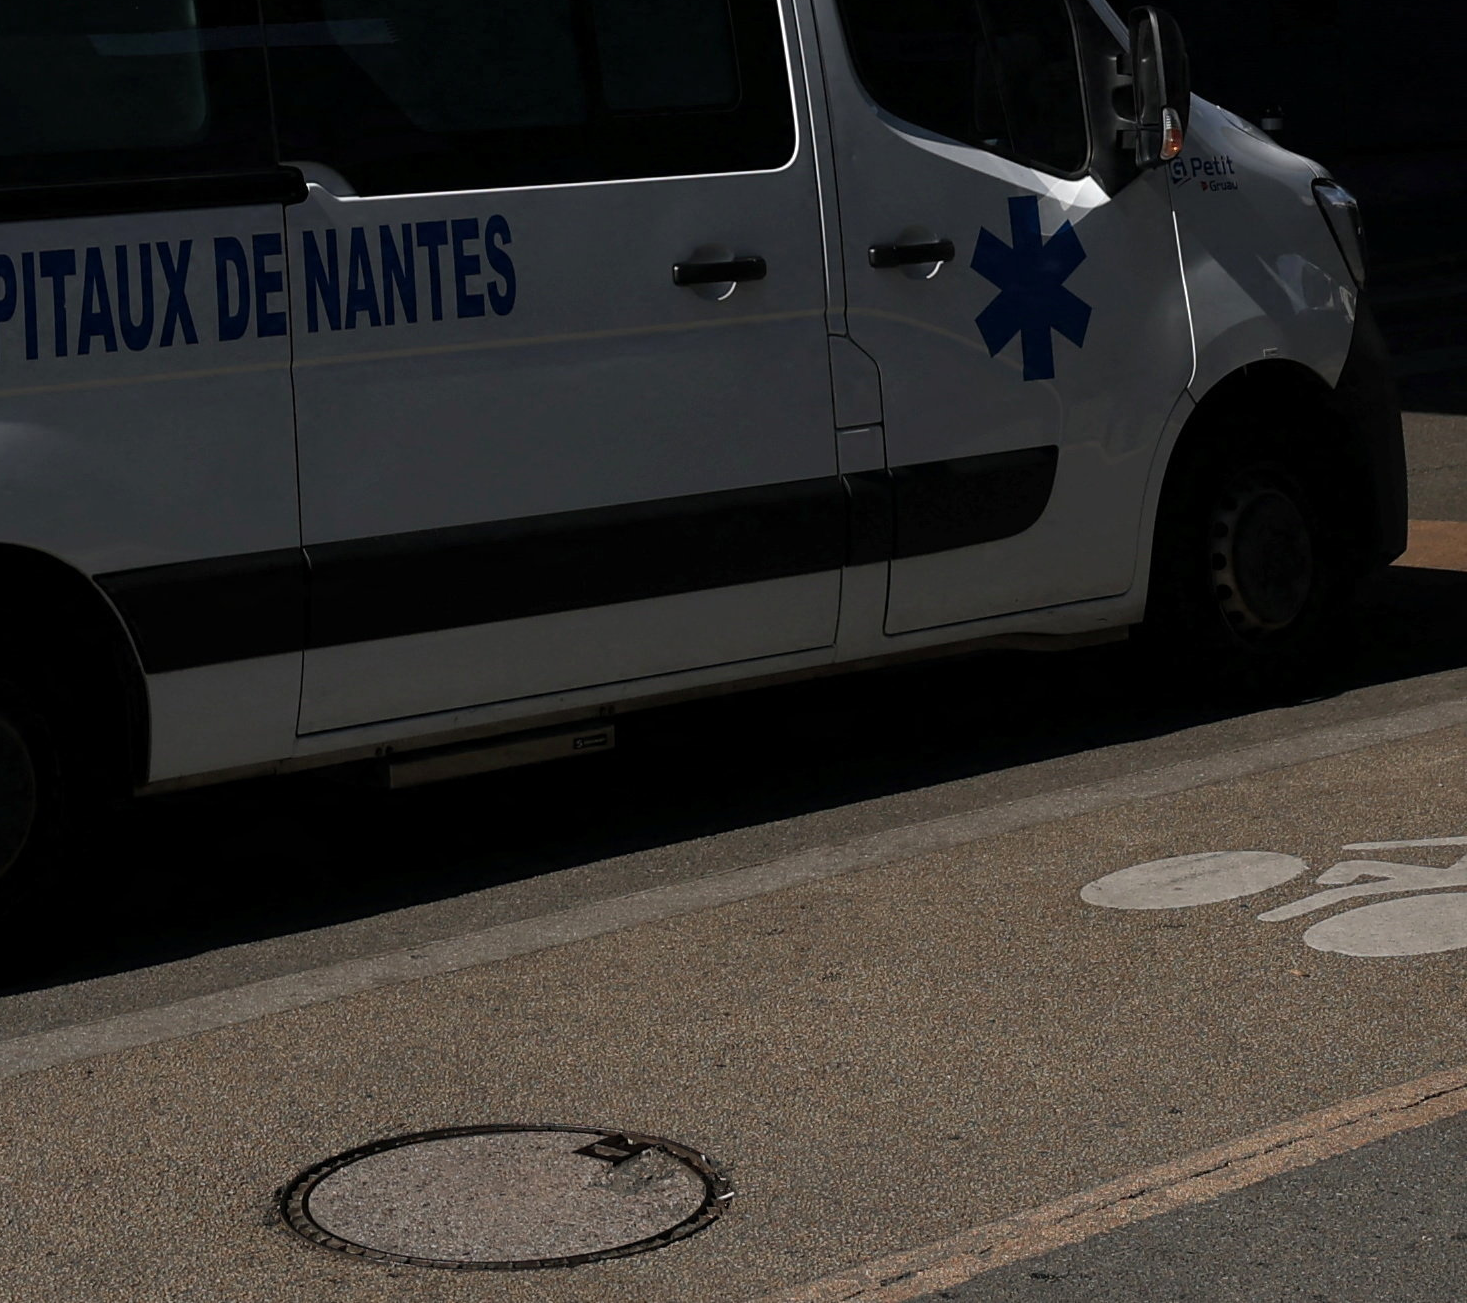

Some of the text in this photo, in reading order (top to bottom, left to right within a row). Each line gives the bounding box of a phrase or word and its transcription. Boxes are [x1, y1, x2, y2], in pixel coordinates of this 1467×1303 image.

[1191, 156, 1235, 177] Petit
[1210, 180, 1238, 192] Gruau
[213, 232, 288, 342] DE
[302, 214, 517, 333] NANTES
